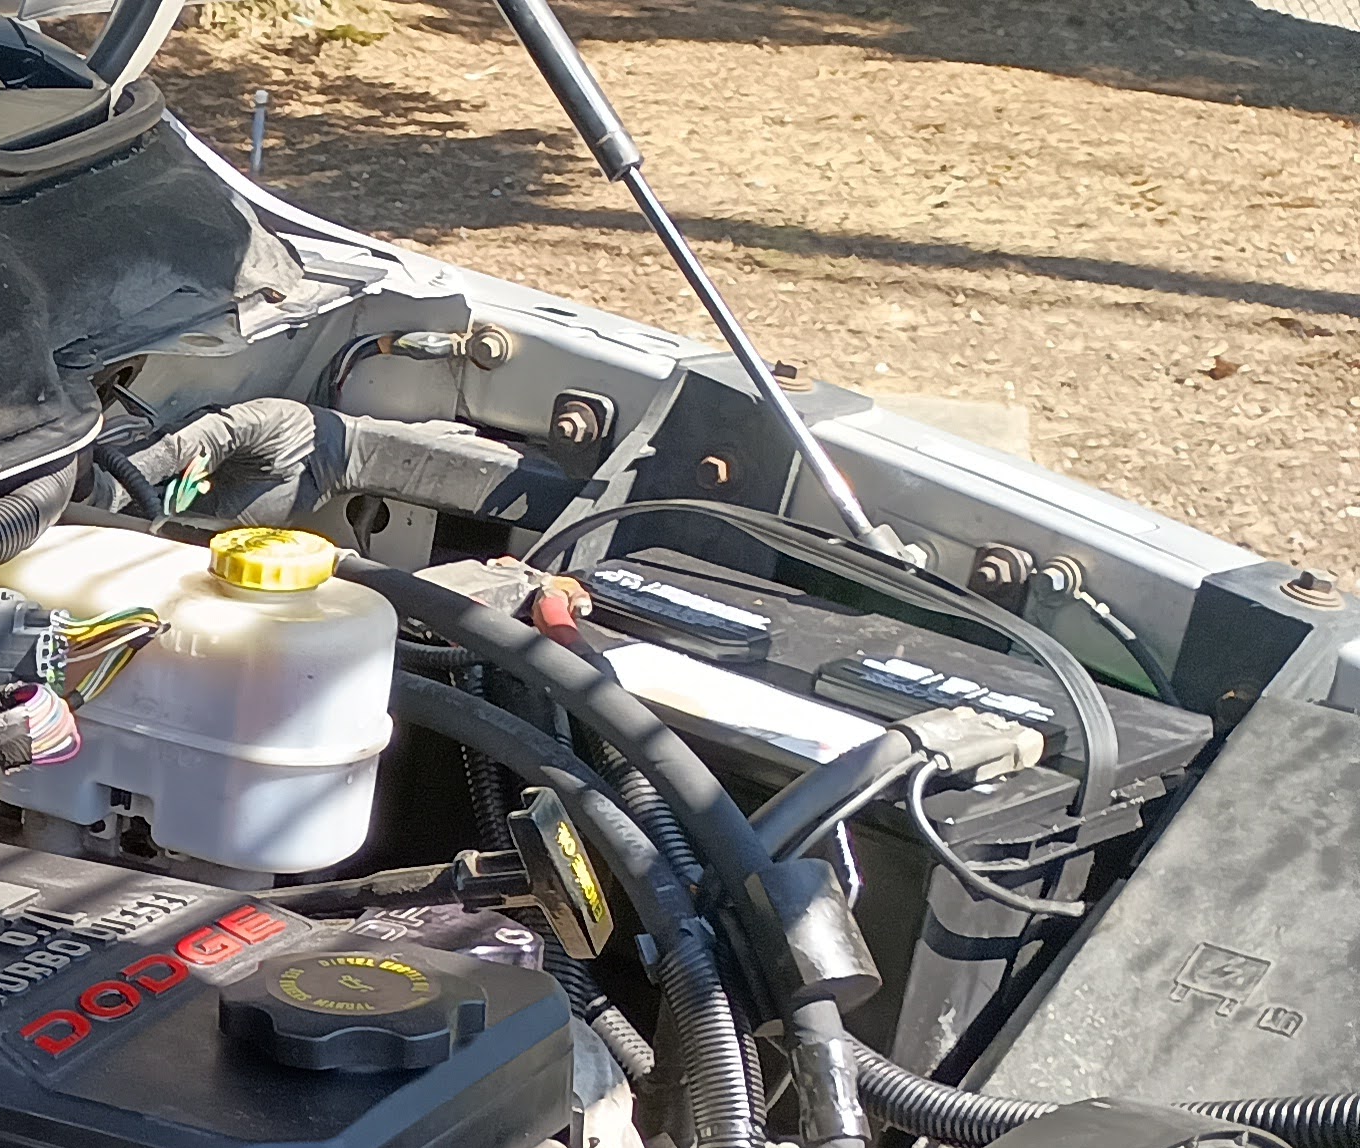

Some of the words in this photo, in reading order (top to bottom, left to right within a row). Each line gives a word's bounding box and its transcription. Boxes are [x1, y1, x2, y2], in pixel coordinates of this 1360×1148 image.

[75, 893, 198, 946] DIESEL
[20, 904, 287, 1056] DODGE
[318, 957, 375, 967] DIESEL
